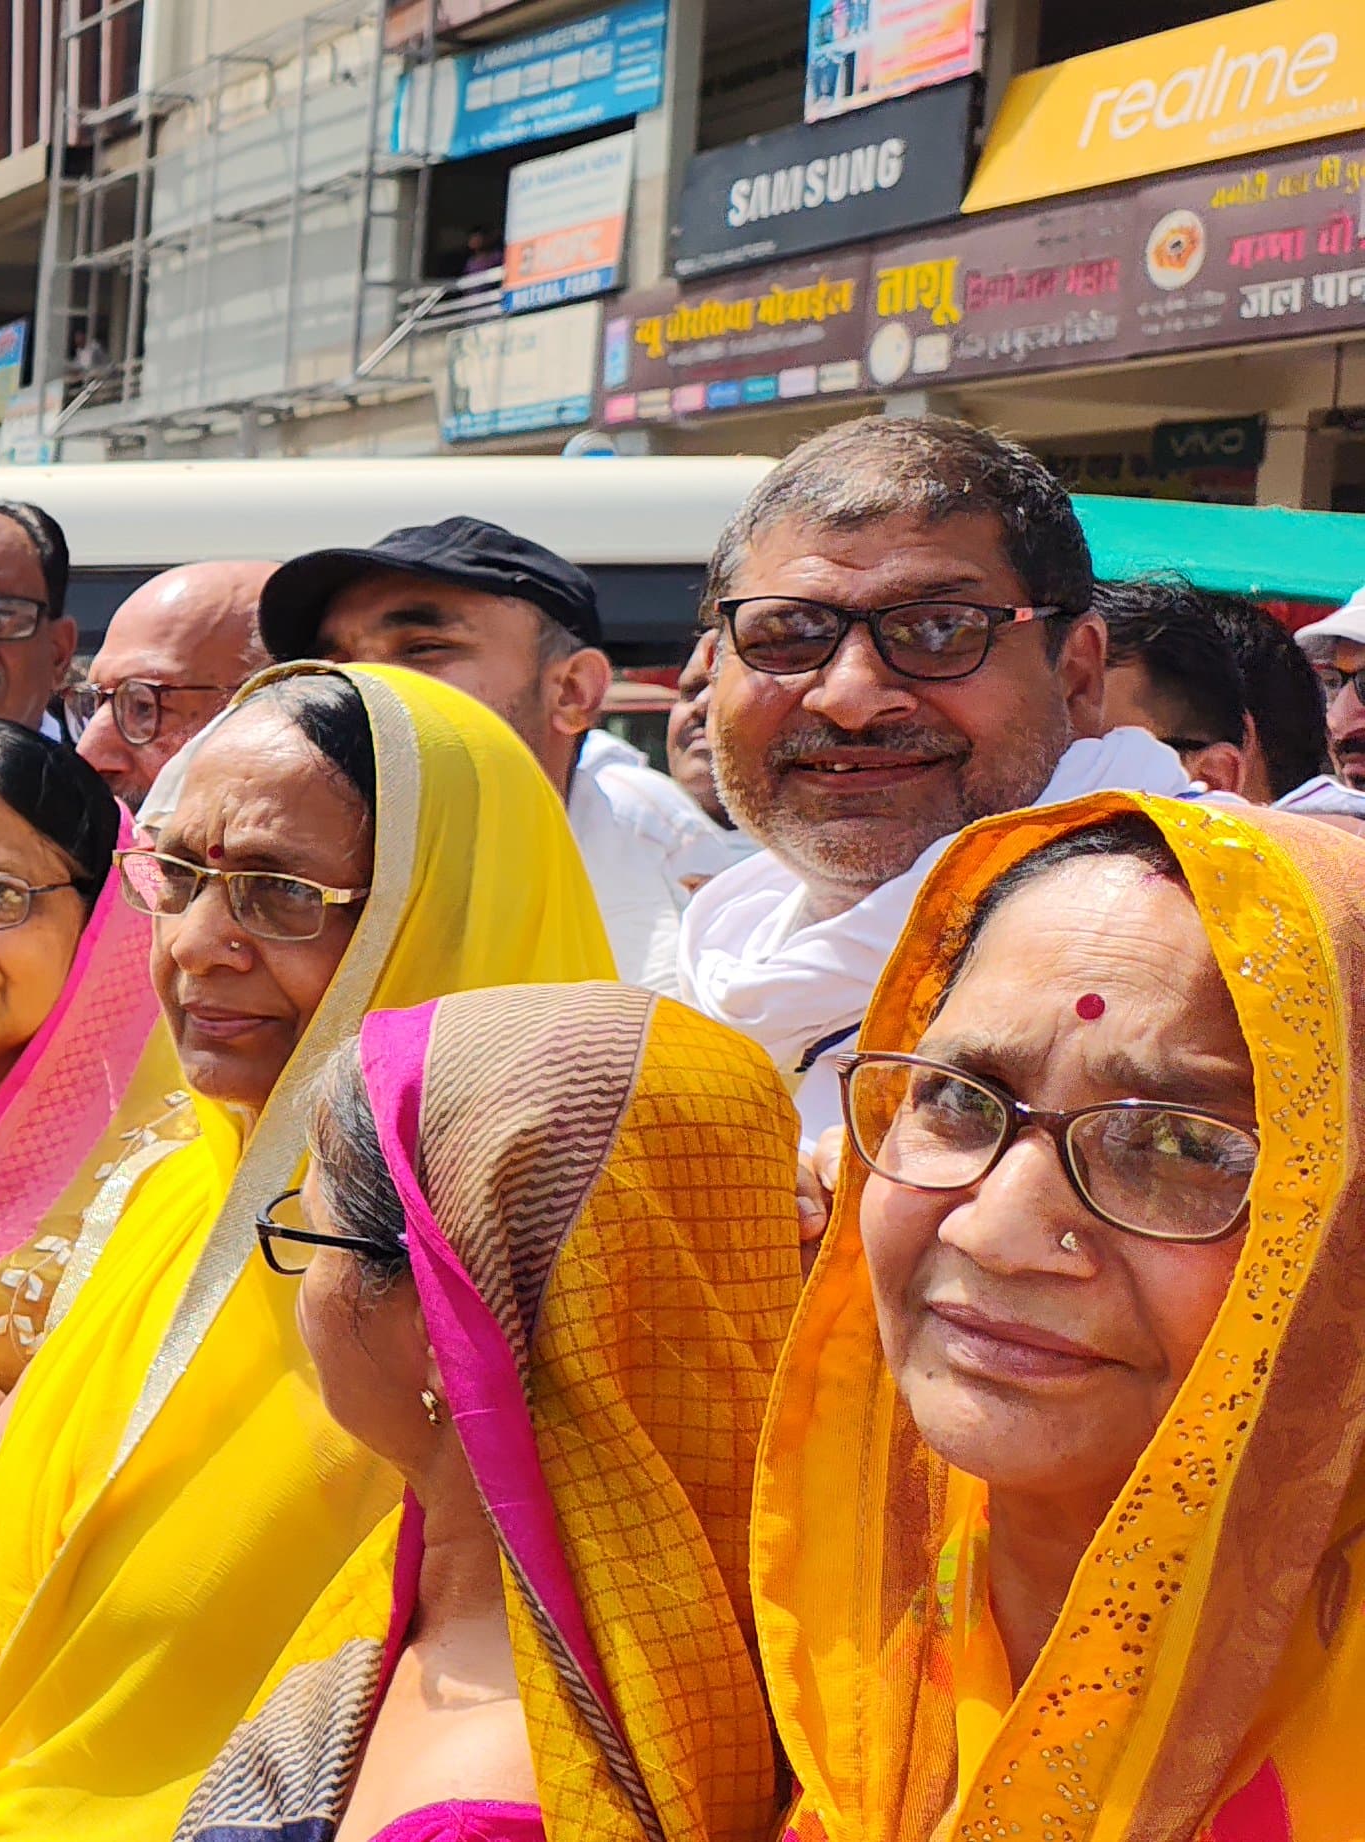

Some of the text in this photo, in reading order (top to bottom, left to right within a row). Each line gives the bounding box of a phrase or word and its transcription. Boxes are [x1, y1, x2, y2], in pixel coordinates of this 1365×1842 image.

[1077, 31, 1339, 151] realme
[727, 137, 908, 228] SAMSUNG
[876, 256, 962, 327] ताशू
[1239, 277, 1305, 319] जल
